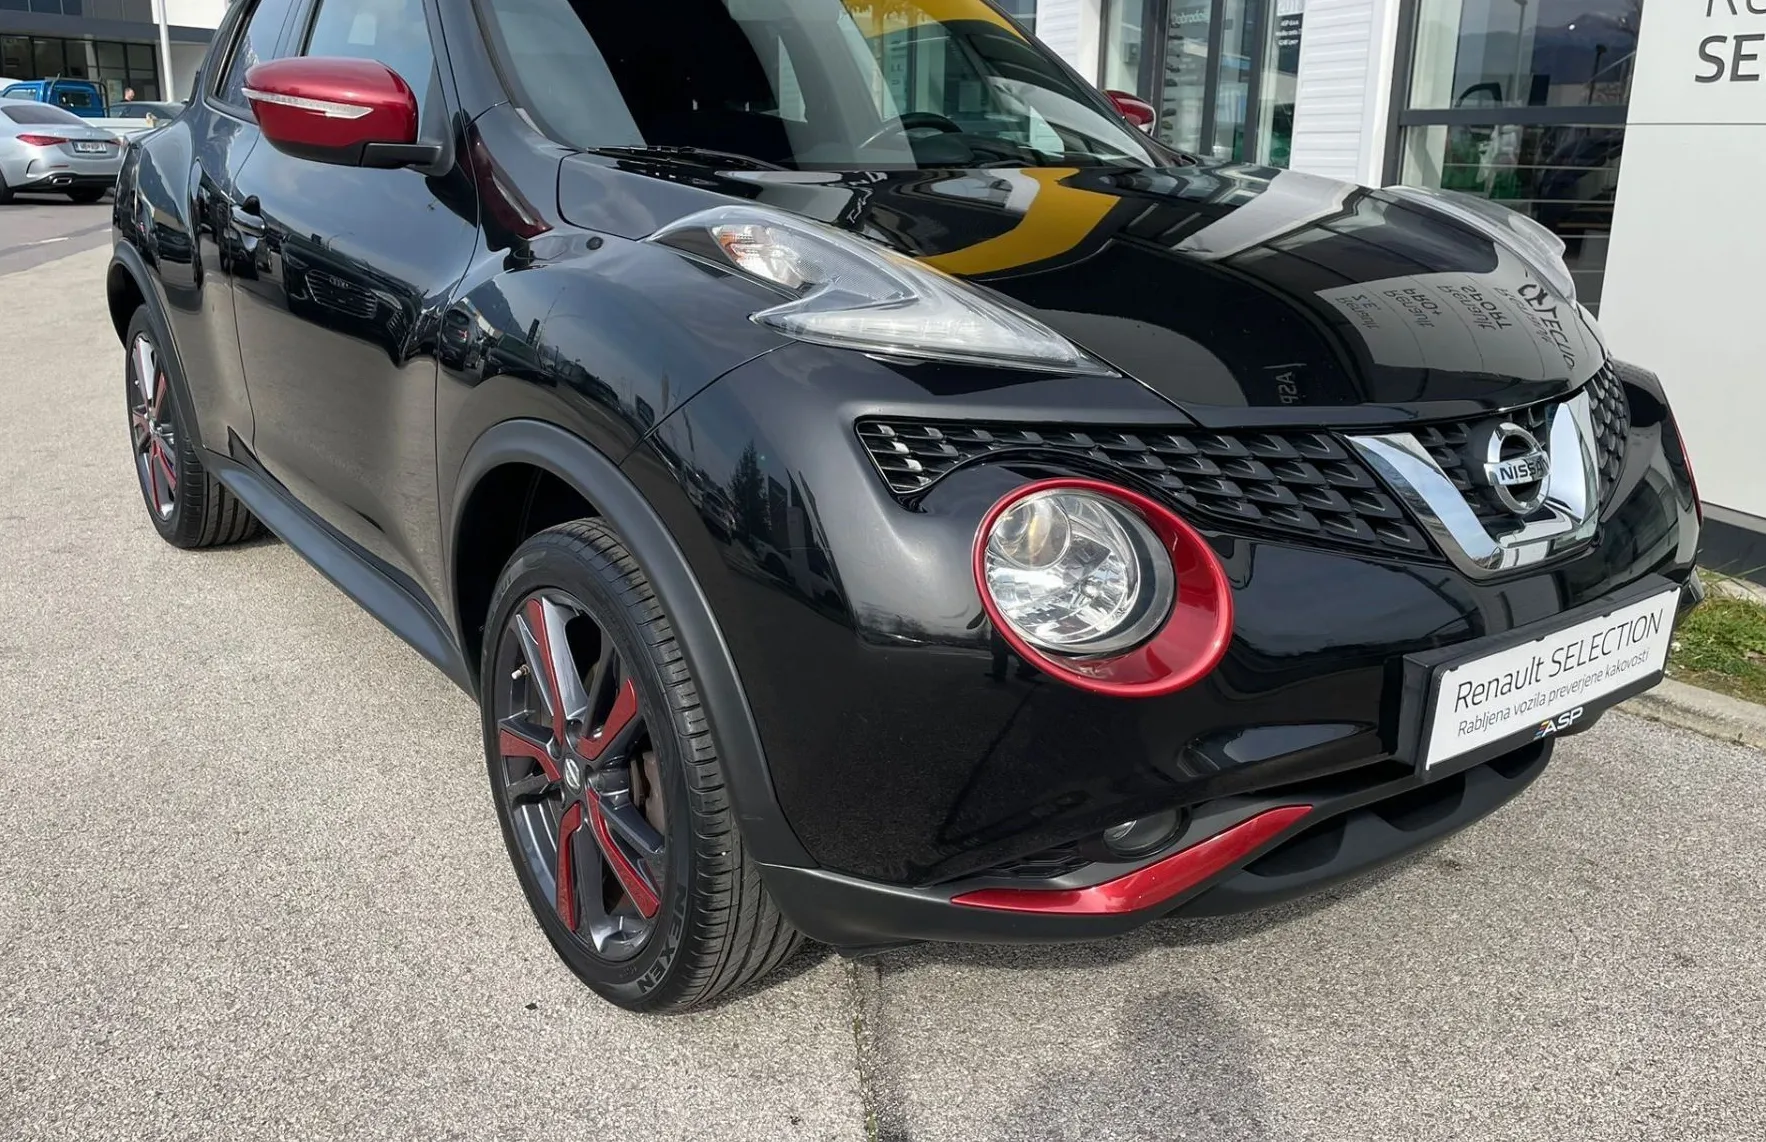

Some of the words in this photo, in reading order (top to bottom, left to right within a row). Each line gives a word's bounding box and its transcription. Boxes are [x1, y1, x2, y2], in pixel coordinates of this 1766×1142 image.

[1695, 34, 1766, 83] SE
[1454, 656, 1544, 713] Renault
[1549, 608, 1664, 678] SELECTION
[1457, 704, 1511, 737] Rabljena
[1513, 691, 1547, 717] vozila
[1548, 668, 1604, 707] preverjene
[1605, 647, 1650, 679] kakovosti
[1536, 706, 1584, 739] ASP
[636, 884, 687, 994] NEXEN
